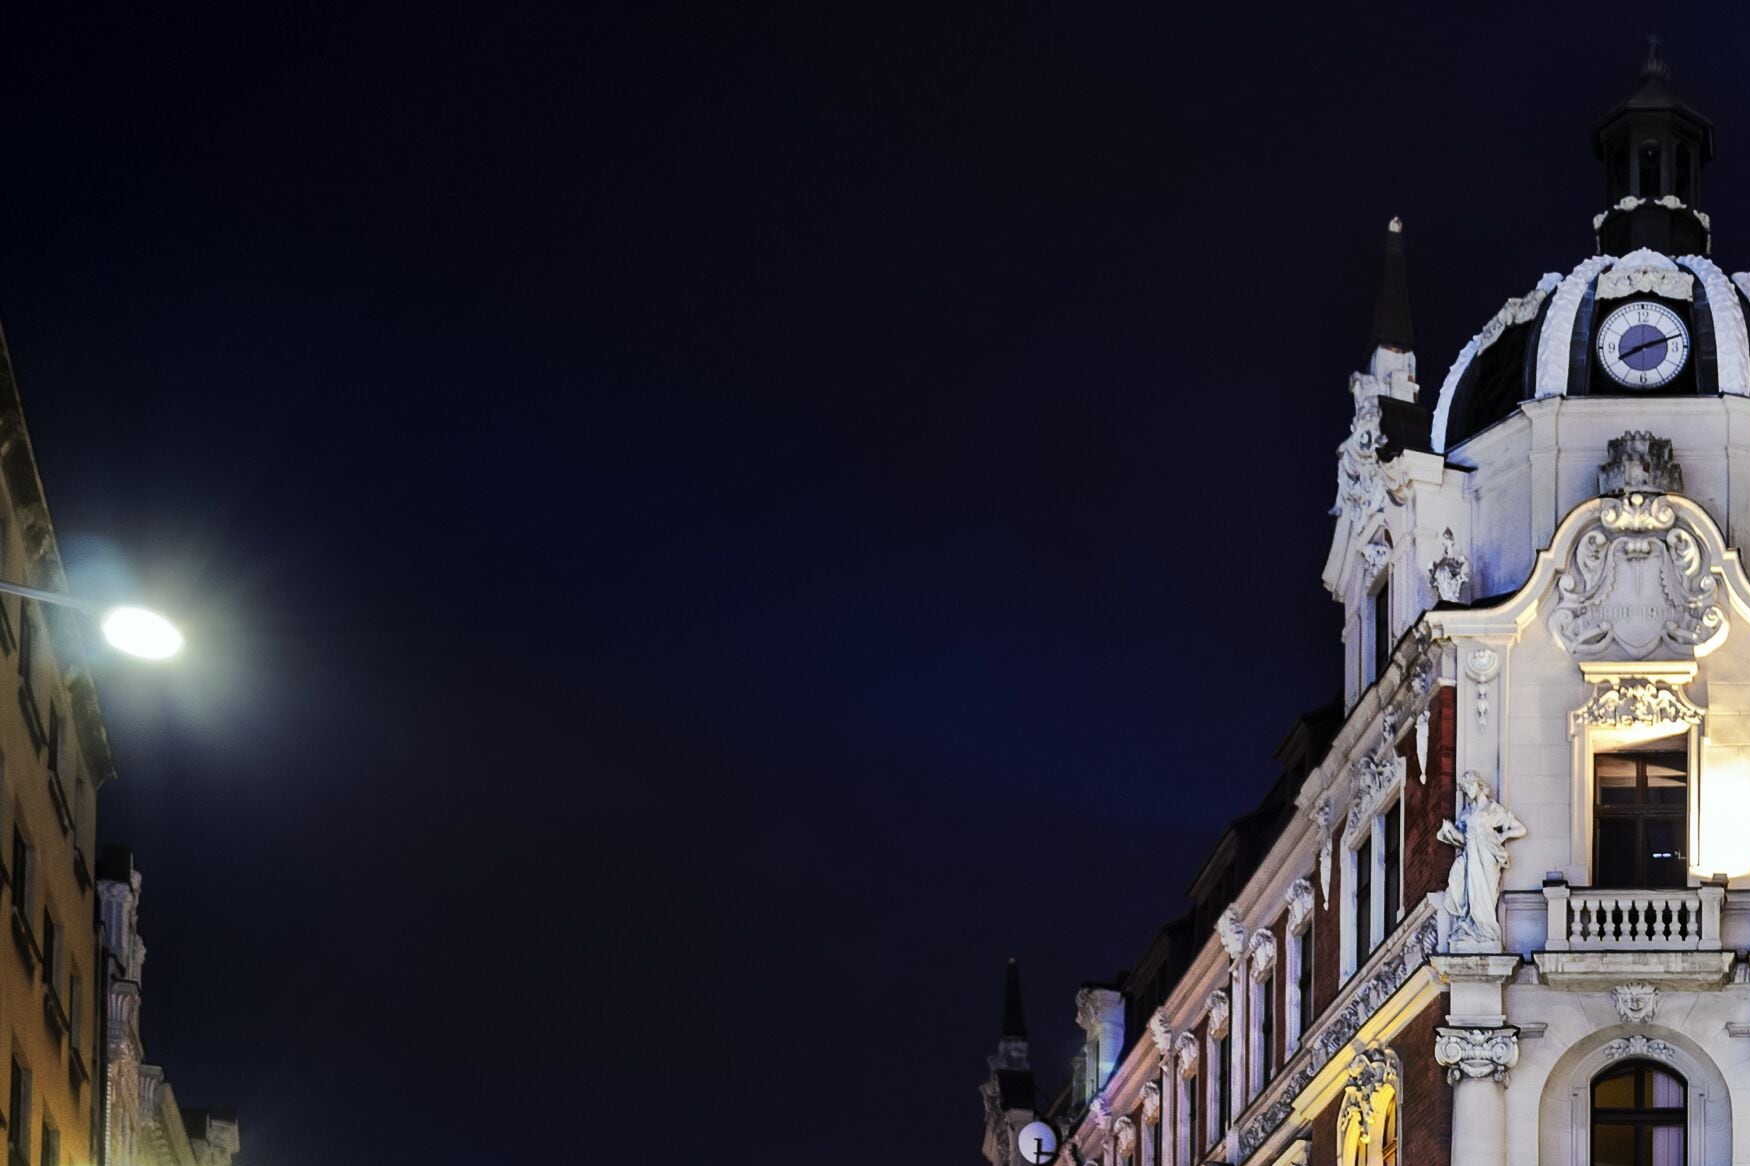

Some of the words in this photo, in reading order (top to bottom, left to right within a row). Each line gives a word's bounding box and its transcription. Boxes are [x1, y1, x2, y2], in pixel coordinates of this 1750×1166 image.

[1637, 311, 1649, 323] 12
[1608, 343, 1616, 354] 9
[1671, 341, 1679, 353] 3
[1640, 373, 1648, 384] 6
